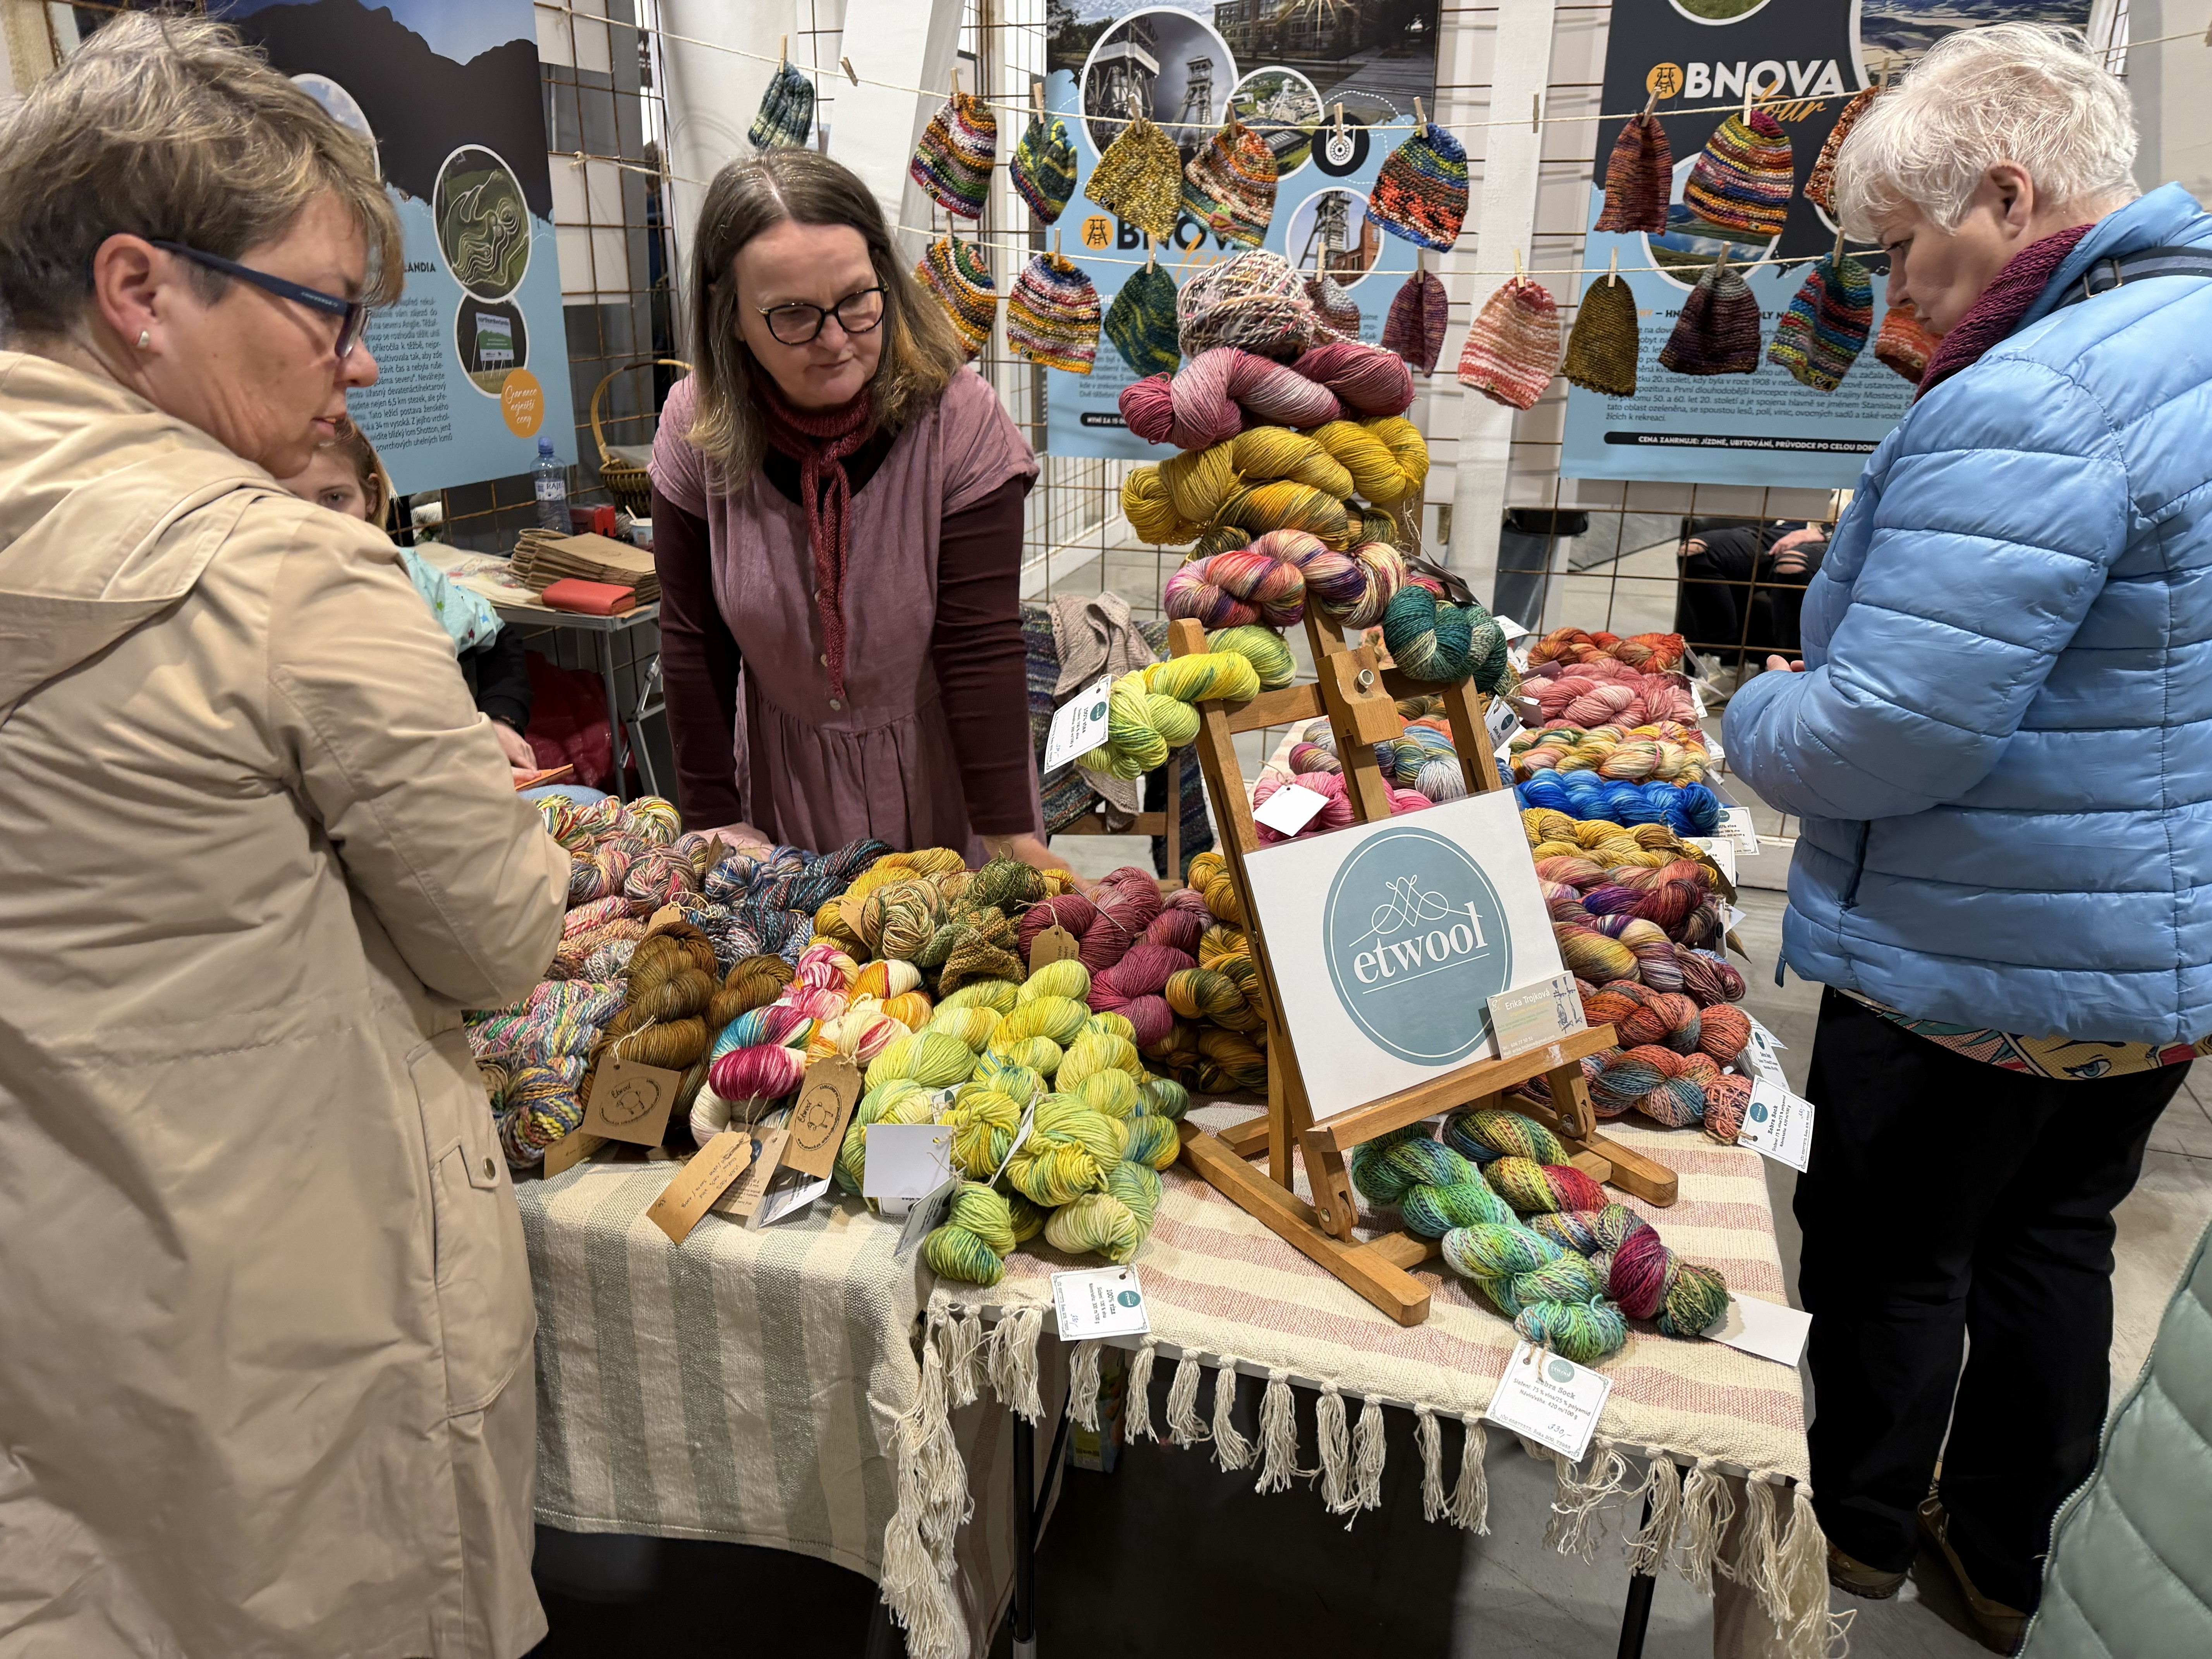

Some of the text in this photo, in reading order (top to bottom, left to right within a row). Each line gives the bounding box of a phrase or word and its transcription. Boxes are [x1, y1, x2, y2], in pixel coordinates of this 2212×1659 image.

[1684, 59, 1845, 98] BNOVA
[405, 262, 436, 273] ANDIA
[1639, 336, 1657, 344] obyt
[375, 354, 409, 363] ekultivovala
[396, 364, 404, 373] čas
[412, 363, 429, 372] nebyla
[418, 373, 445, 382] Neváhejte
[1693, 377, 1706, 385] kdy
[388, 381, 446, 395] devatenáctihektarový
[1752, 388, 1788, 397] koncepce
[388, 398, 397, 407] 6,5
[398, 397, 406, 405] km
[408, 395, 426, 404] stezek,
[1714, 397, 1738, 405] století
[1756, 398, 1786, 407] spojena
[384, 409, 398, 417] ležící
[400, 407, 422, 417] postava
[424, 402, 448, 413] ženského
[1649, 405, 1688, 413] ozeleněna,
[390, 418, 410, 429] vysoká.
[388, 428, 404, 438] blízký
[405, 428, 416, 436] lom
[416, 426, 439, 435] Shotton,
[376, 439, 412, 452] povrchových
[1659, 436, 1700, 445] ZAHRNUJE:
[1700, 437, 1728, 446] JÍZDNÉ,
[1730, 439, 1774, 448] UBYTOVÁNÍ,
[1776, 439, 1816, 449] PRŮVODCE
[1353, 901, 1489, 984] etwool
[1505, 998, 1522, 1010] Erika
[1522, 987, 1551, 1006] Trojková
[1513, 1377, 1532, 1390] Složení:
[1544, 1391, 1563, 1403] vlna/25
[1567, 1402, 1591, 1417] polyamid
[1557, 1386, 1576, 1400] Sock
[1547, 1401, 1558, 1410] 420
[1557, 1406, 1574, 1417] m/100
